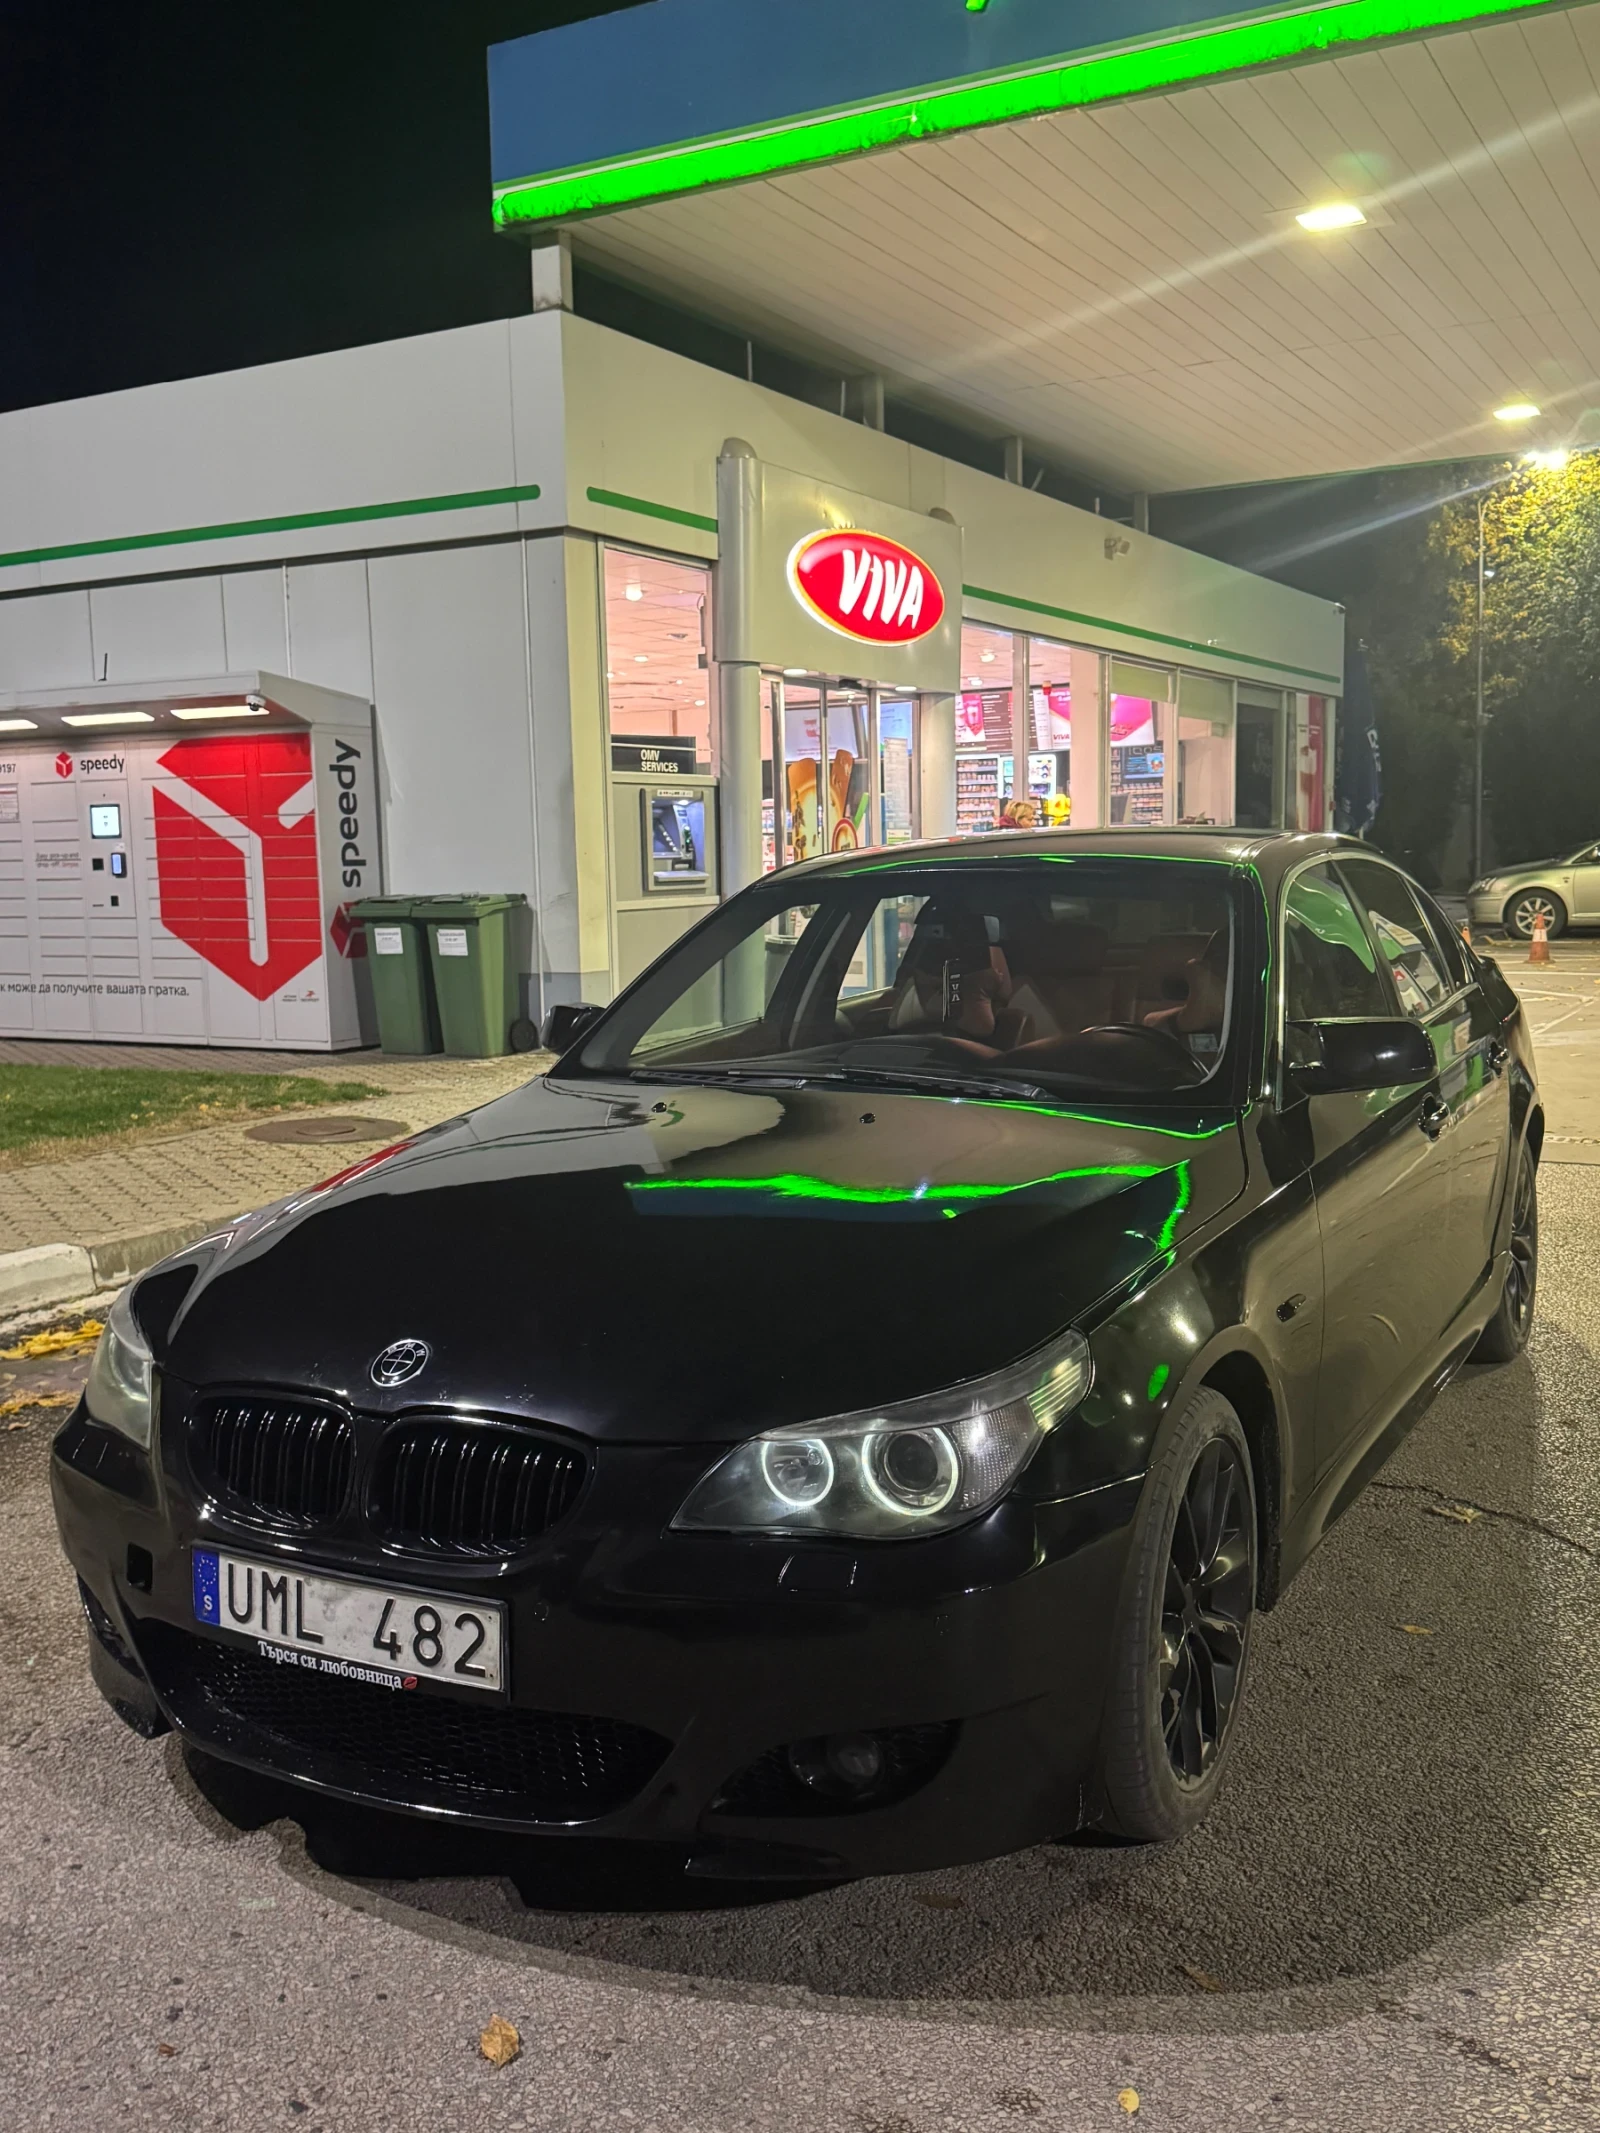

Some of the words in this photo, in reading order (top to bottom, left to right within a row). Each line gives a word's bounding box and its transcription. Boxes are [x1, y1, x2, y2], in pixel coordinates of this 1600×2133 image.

[839, 548, 924, 629] VIVA
[80, 753, 125, 774] speedy
[640, 749, 660, 761] OMV
[641, 761, 678, 773] SERVICES
[329, 738, 367, 888] speedy
[8, 985, 37, 994] може
[38, 985, 51, 994] да
[53, 985, 103, 997] получите
[106, 986, 146, 995] вашата
[203, 1594, 213, 1611] S
[228, 1563, 324, 1644] UML
[373, 1597, 486, 1678] 482
[257, 1640, 299, 1665] Търся
[300, 1655, 318, 1670] си
[319, 1659, 403, 1691] любовница
